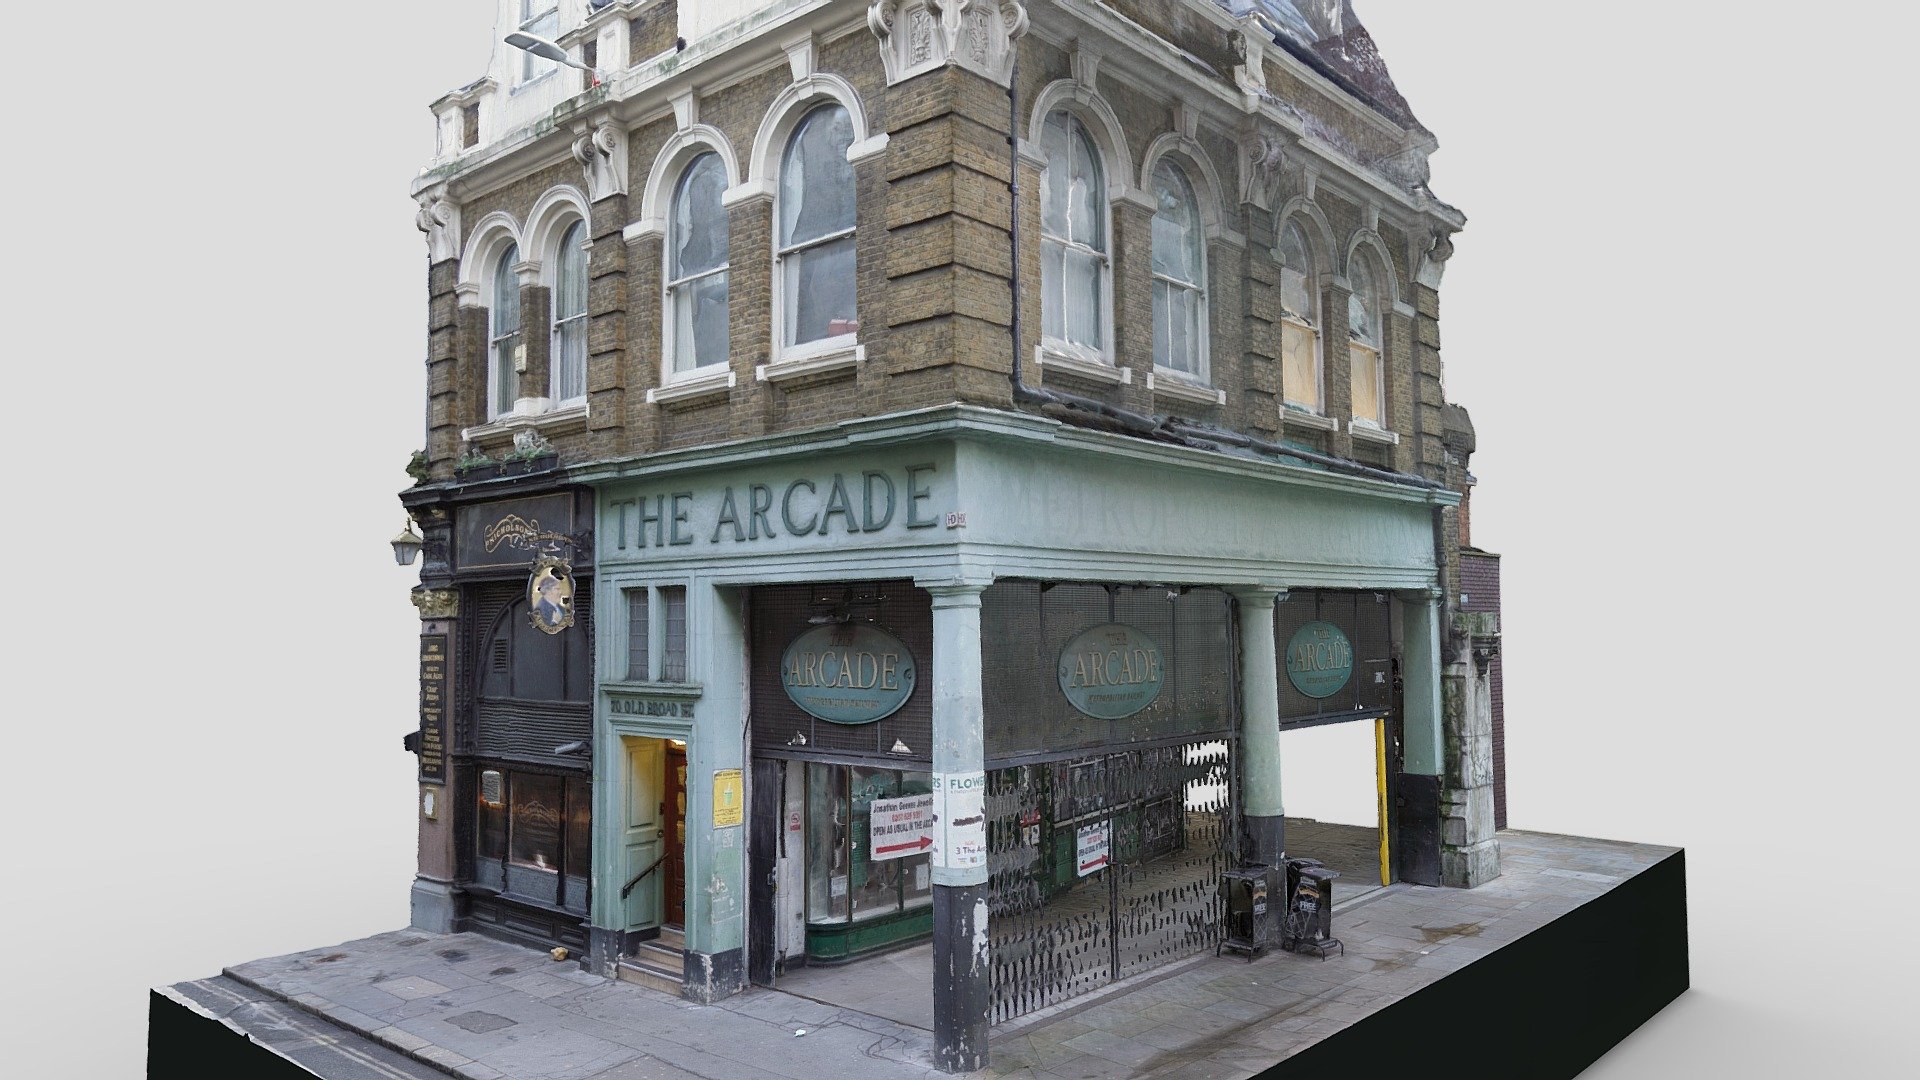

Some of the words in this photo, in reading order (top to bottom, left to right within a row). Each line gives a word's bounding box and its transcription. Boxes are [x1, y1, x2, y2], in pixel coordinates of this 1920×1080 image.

[610, 491, 693, 550] THE
[711, 463, 939, 543] ARCADE
[1068, 649, 1158, 688] ARCADE
[1292, 641, 1350, 672] ARCADE
[788, 651, 899, 690] ARCADE
[625, 700, 644, 715] OLD
[647, 701, 678, 717] BROAD
[873, 803, 898, 813] Jonathan
[873, 826, 886, 837] OPEN
[887, 824, 893, 834] AS
[894, 823, 908, 834] USUAL
[914, 820, 922, 830] THE
[956, 846, 961, 855] 3
[963, 846, 976, 854] The
